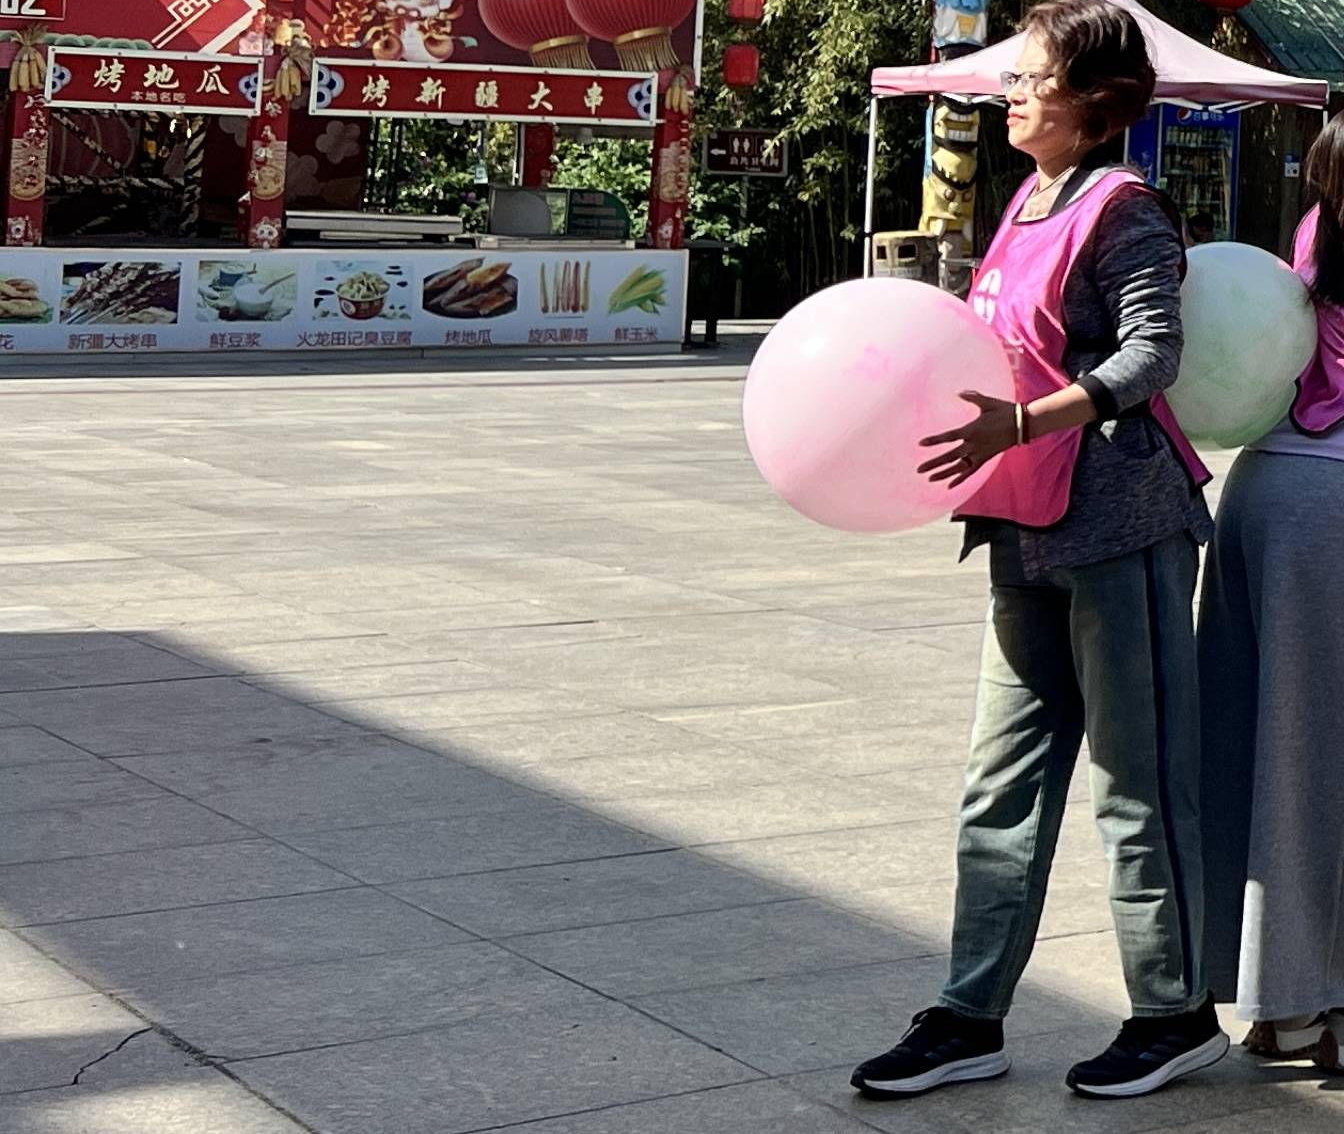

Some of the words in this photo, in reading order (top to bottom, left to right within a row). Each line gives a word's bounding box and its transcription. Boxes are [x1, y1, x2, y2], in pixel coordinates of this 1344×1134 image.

[93, 58, 231, 94] 烤地瓜
[130, 90, 187, 104] 本地名吃
[361, 73, 604, 115] 烤新疆大串
[208, 332, 262, 349] 鲜豆浆
[444, 329, 493, 345] 烤地瓜
[614, 327, 658, 341] 鲜玉米
